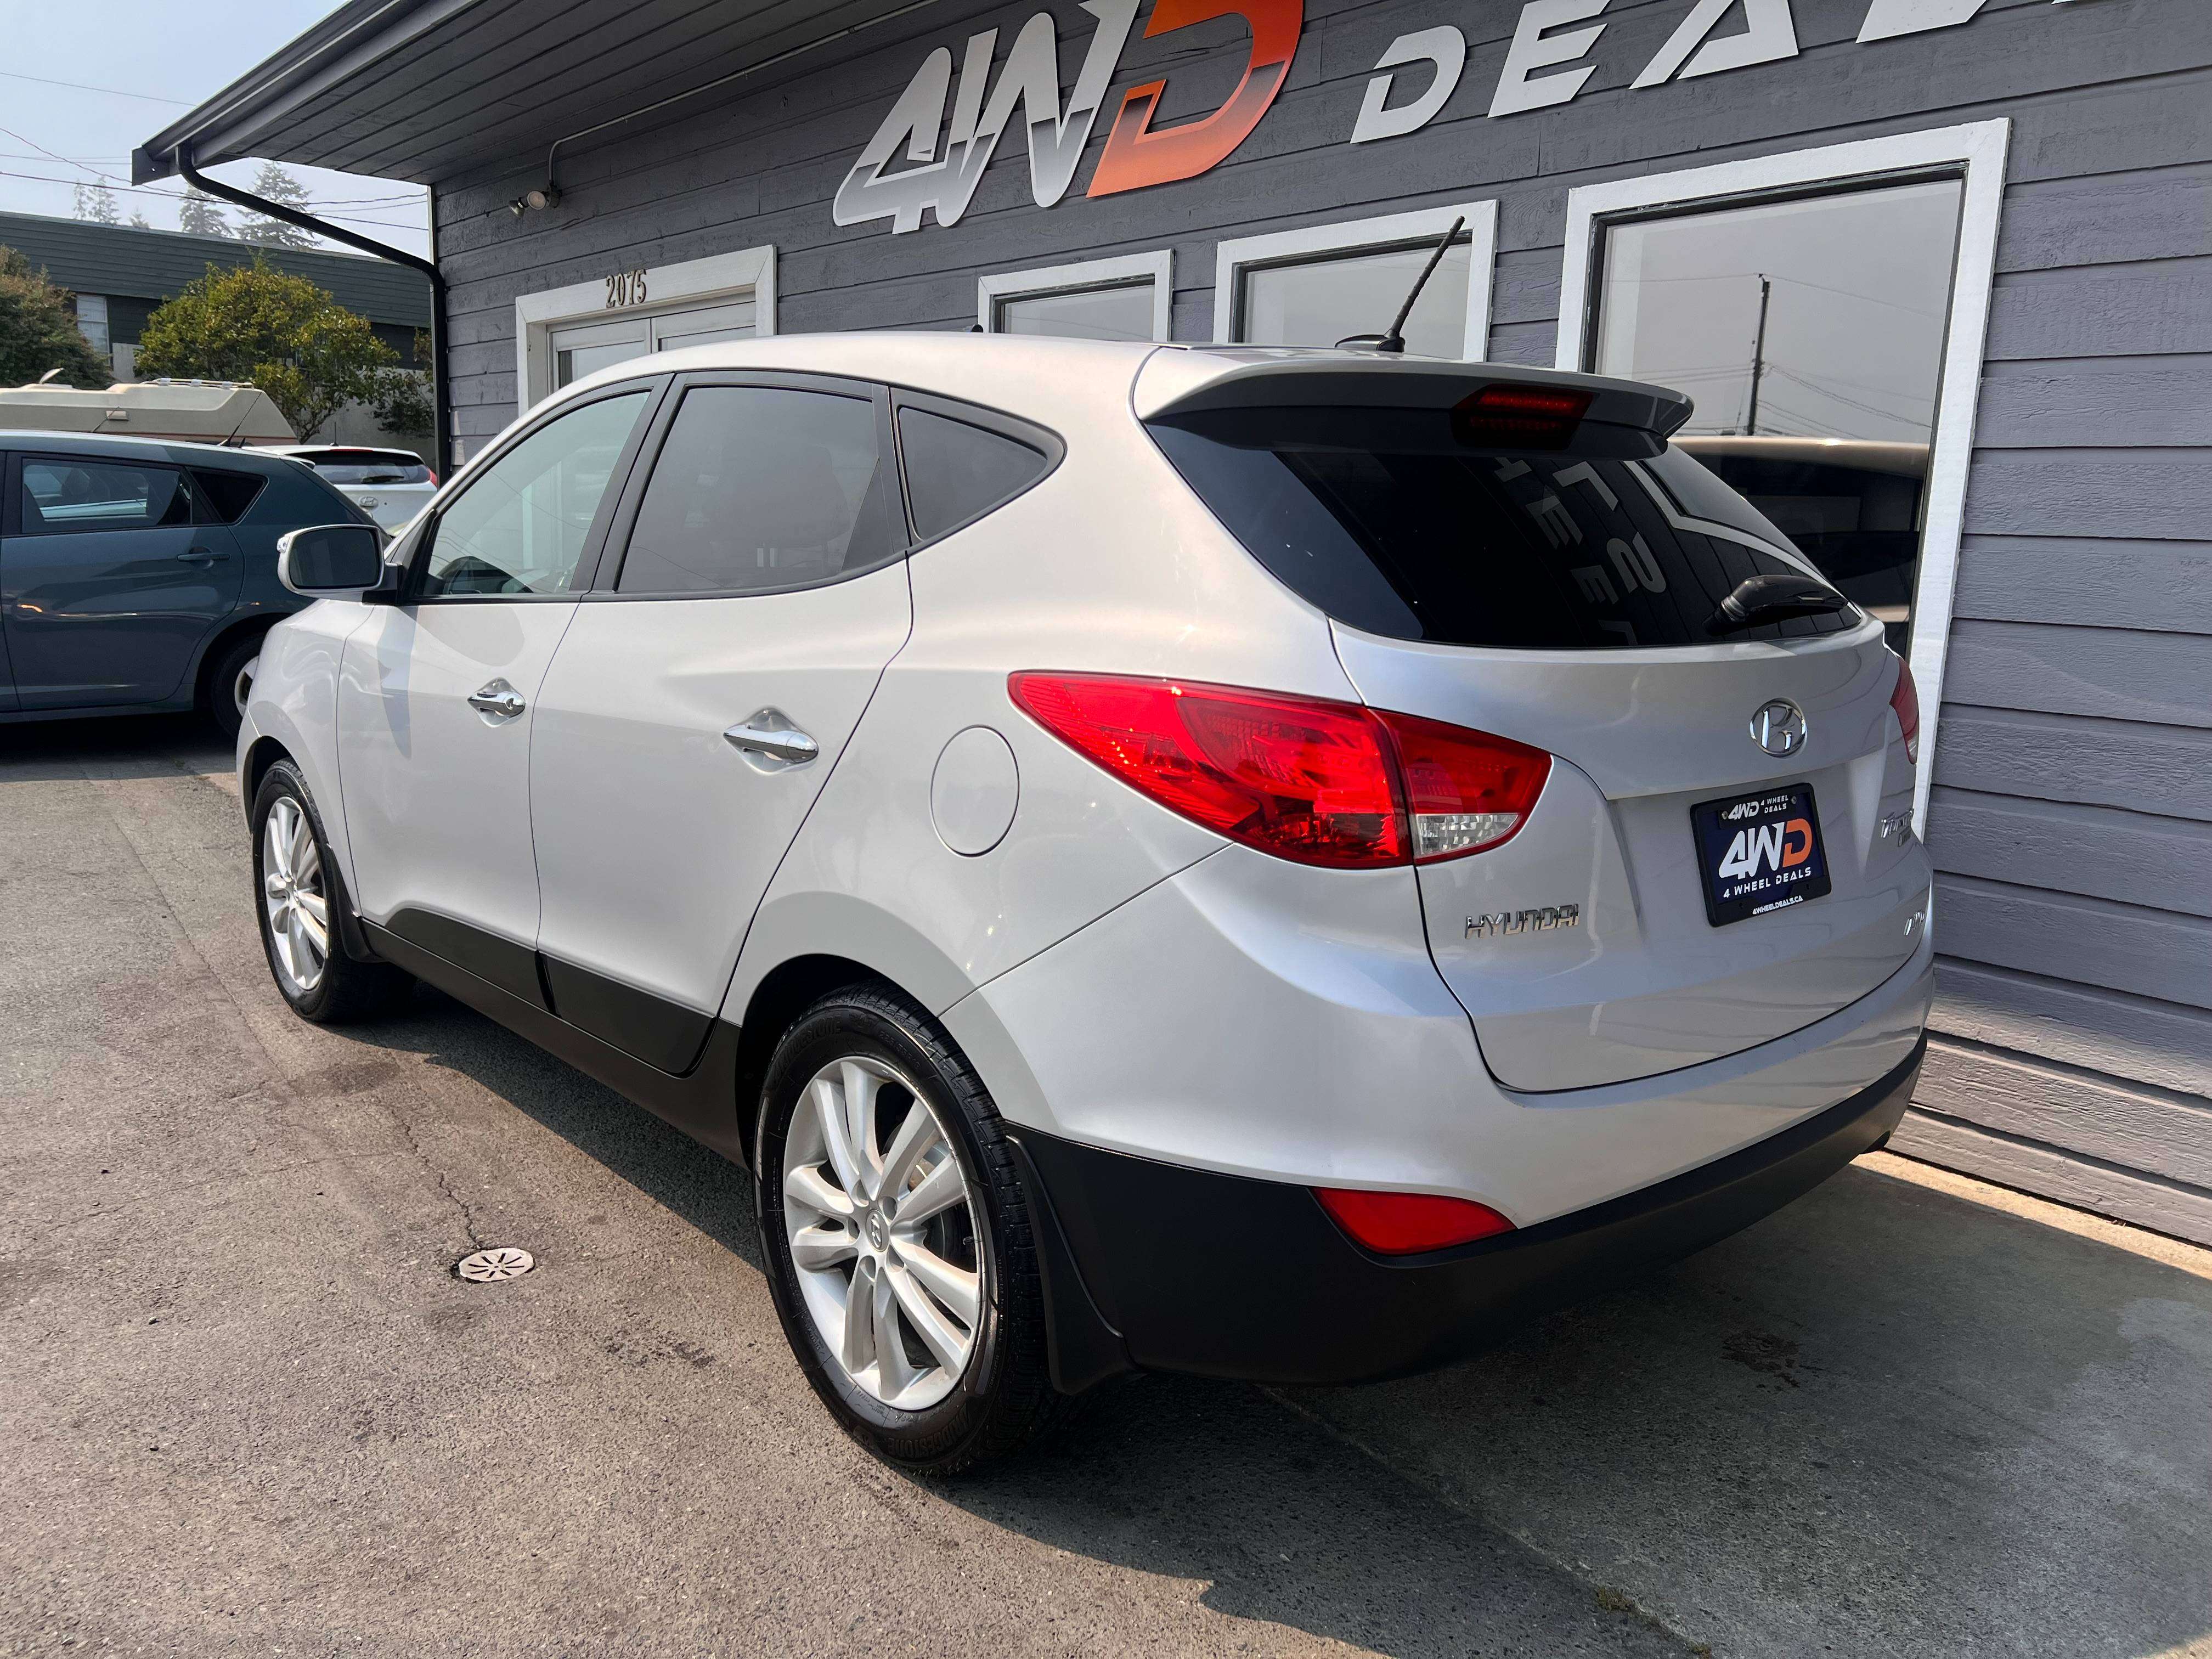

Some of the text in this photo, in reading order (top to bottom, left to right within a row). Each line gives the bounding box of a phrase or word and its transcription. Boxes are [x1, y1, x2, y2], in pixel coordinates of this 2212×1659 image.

[832, 0, 2075, 234] 4WD DEA
[606, 268, 647, 308] 2075
[1728, 801, 1759, 820] 4WD
[1767, 795, 1788, 805] WHEEL
[1764, 803, 1787, 814] DEALS
[1719, 818, 1813, 879] 4WD
[1723, 867, 1811, 898] 4 WHEEL DEALS
[1465, 904, 1579, 940] HYUNDAI
